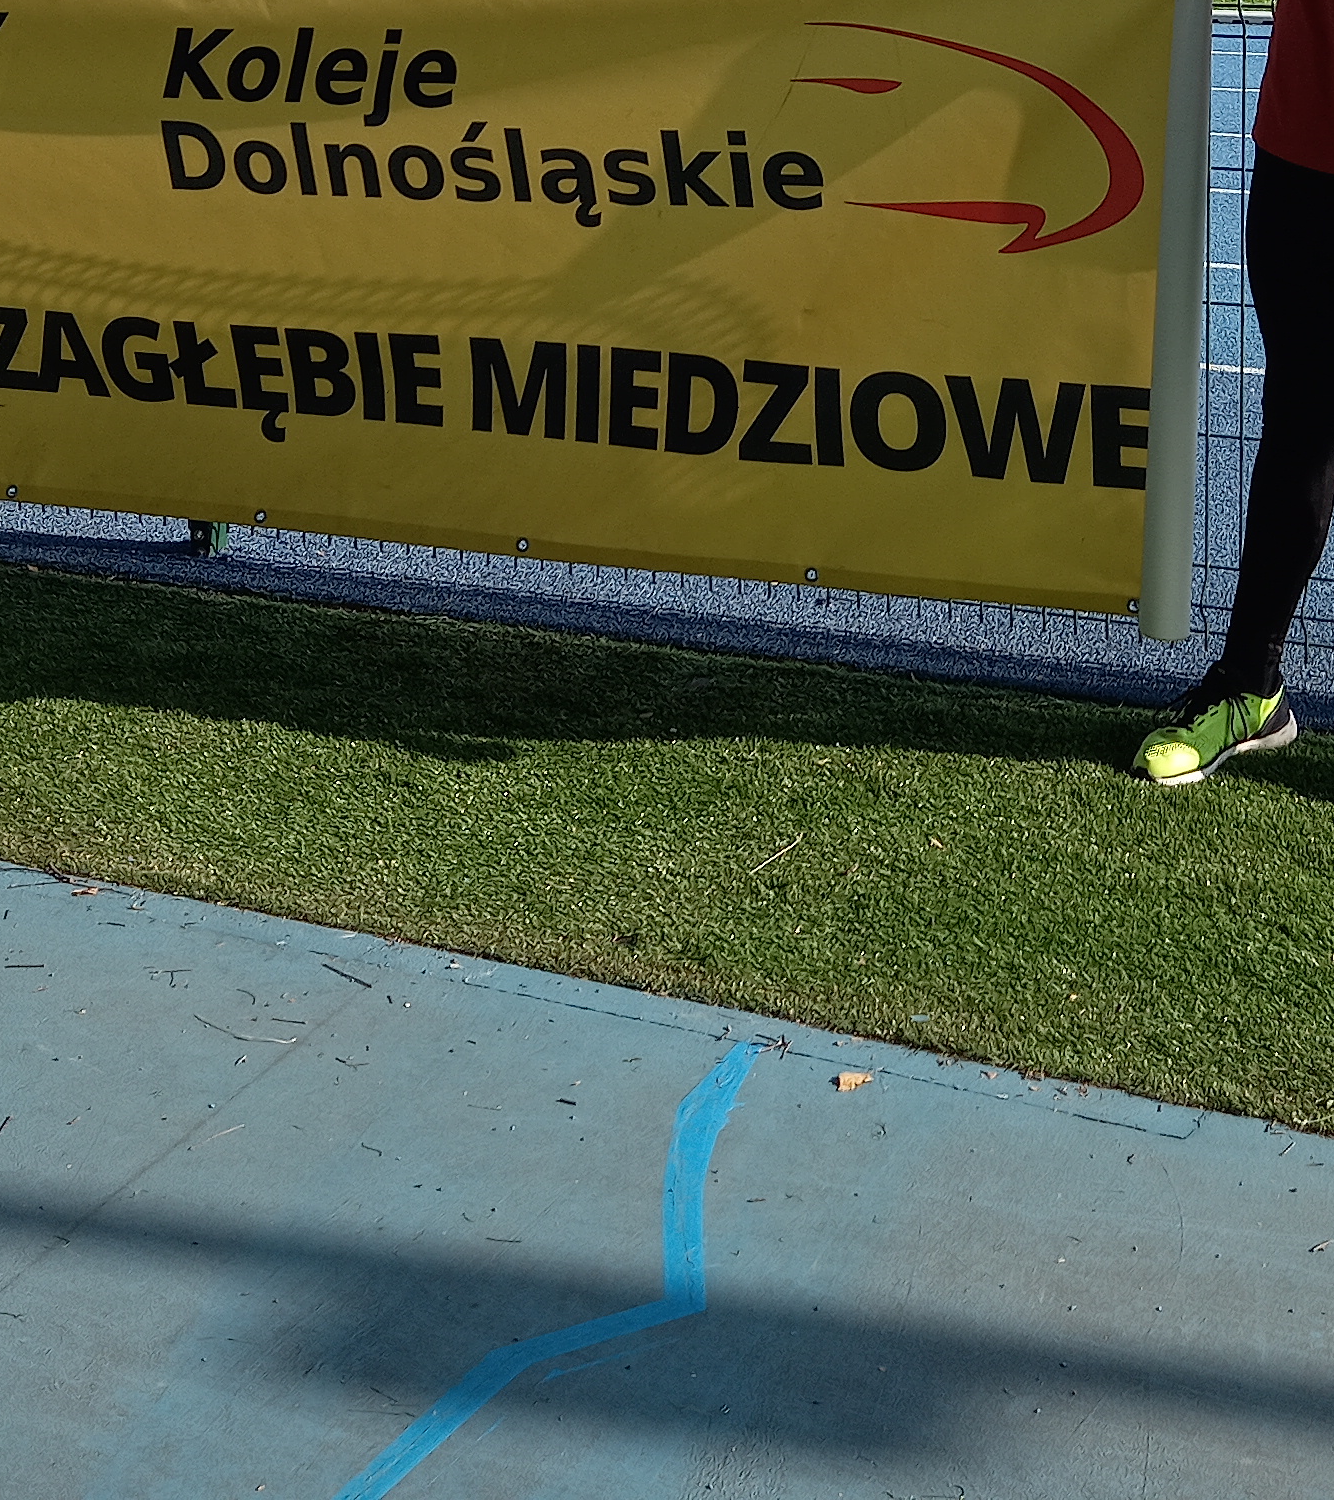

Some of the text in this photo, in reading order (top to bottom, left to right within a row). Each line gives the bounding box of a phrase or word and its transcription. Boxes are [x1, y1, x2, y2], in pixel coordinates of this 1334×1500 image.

[161, 26, 458, 125] Koleje
[160, 119, 825, 228] Dolnośląskie
[469, 335, 1152, 491] MIEDZIOWE
